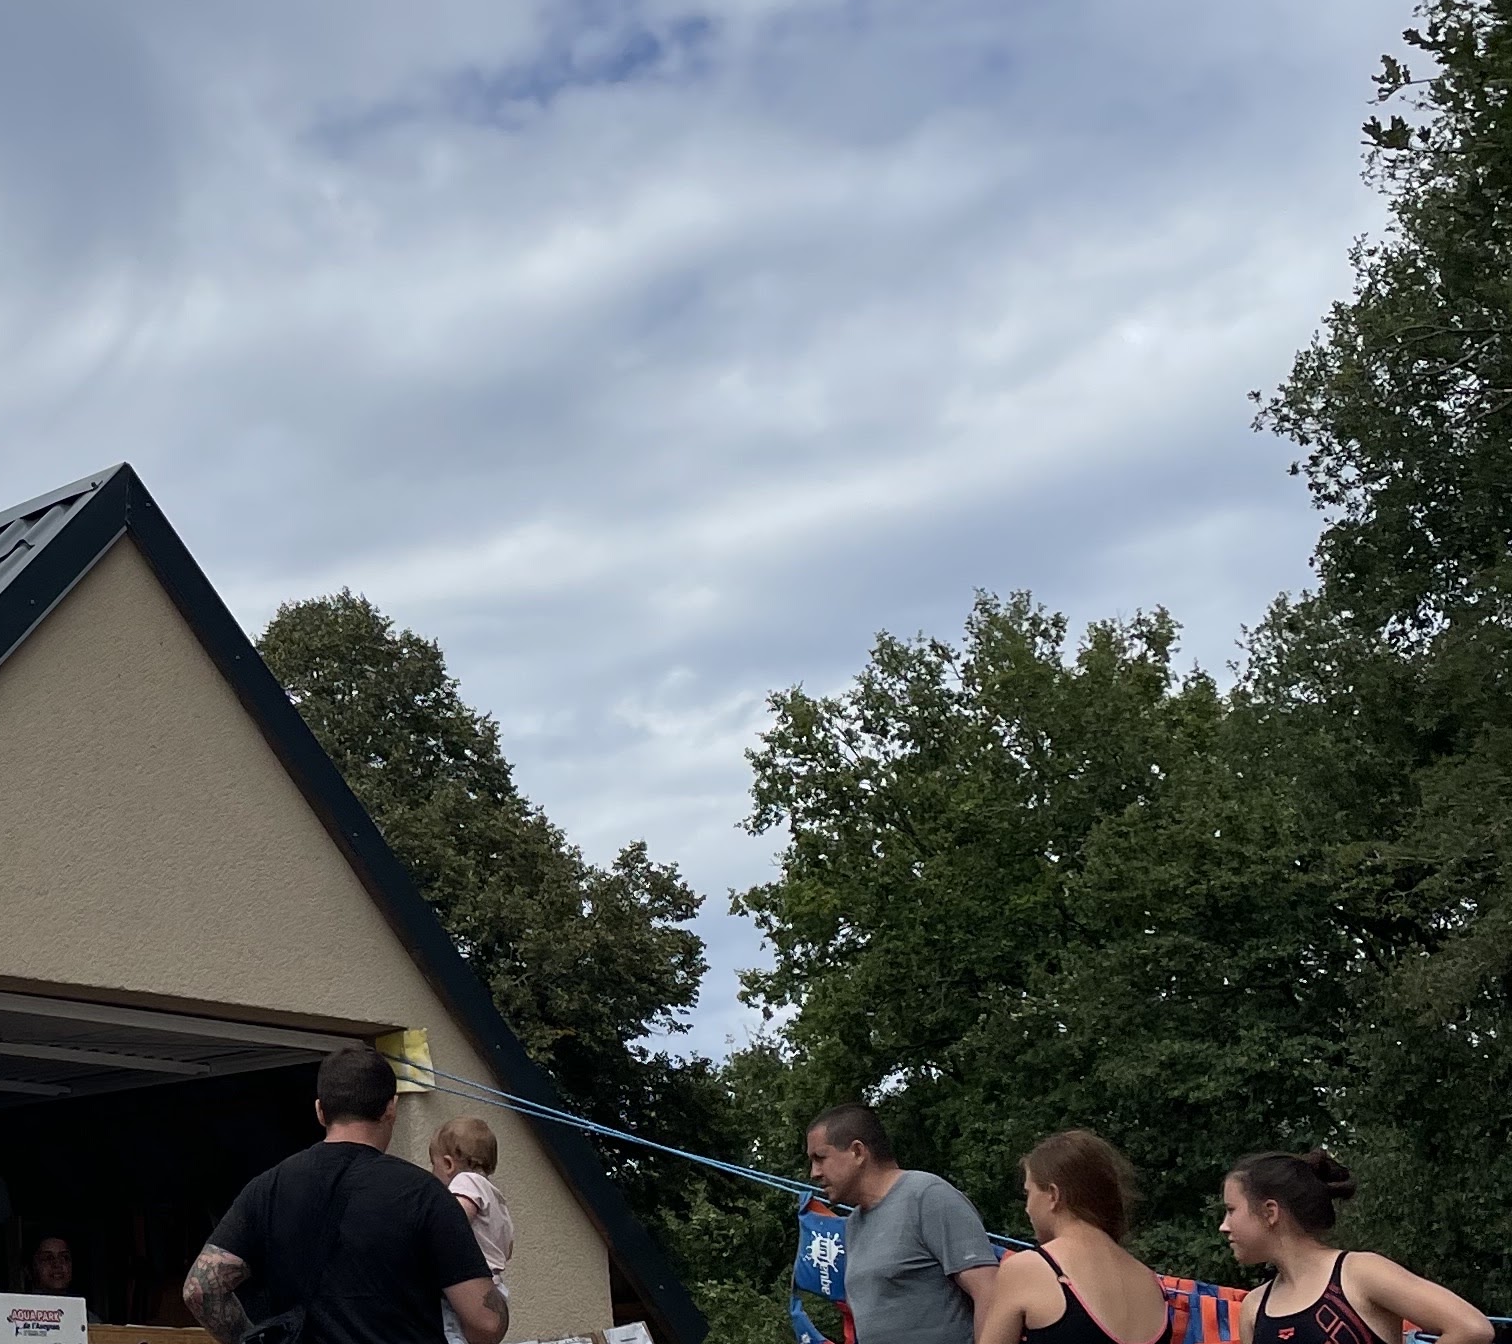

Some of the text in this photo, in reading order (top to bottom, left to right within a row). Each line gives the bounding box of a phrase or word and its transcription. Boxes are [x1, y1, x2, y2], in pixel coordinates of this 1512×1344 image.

[817, 1239, 833, 1296] aquafun
[11, 1309, 61, 1323] AQUA PARK
